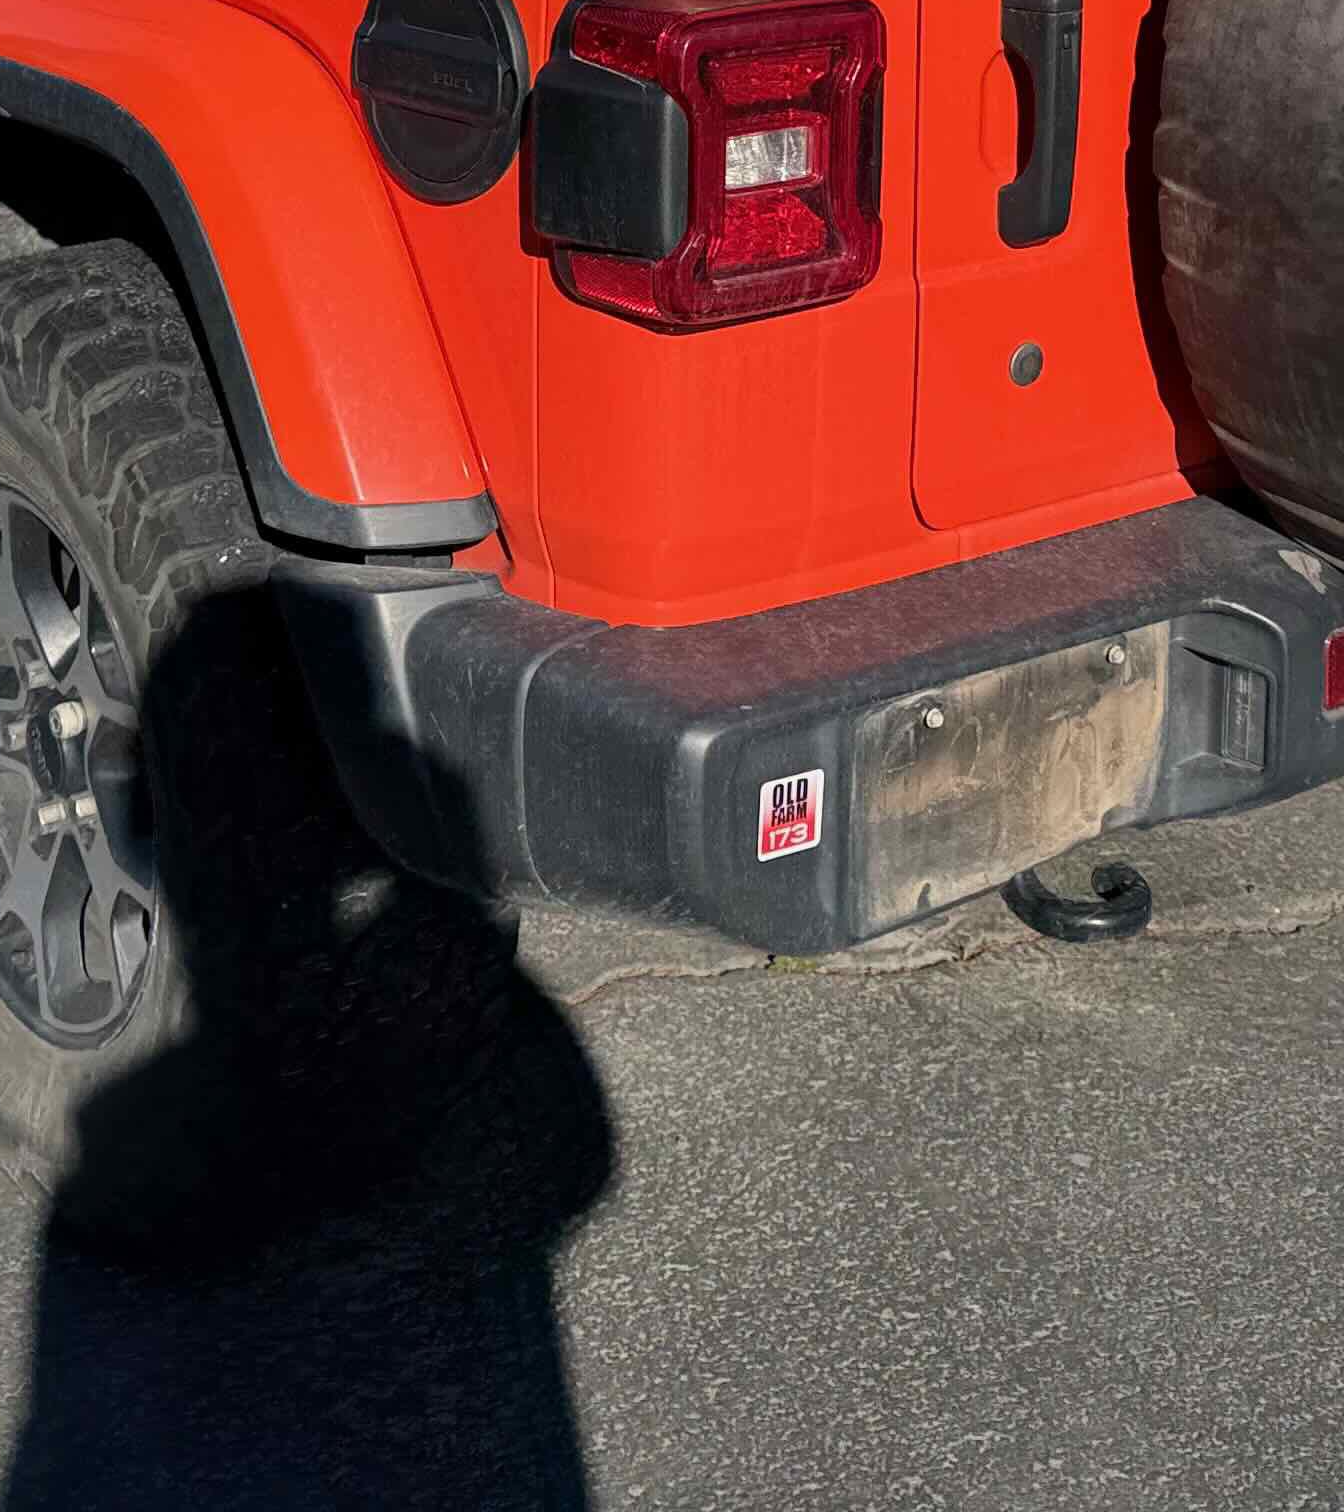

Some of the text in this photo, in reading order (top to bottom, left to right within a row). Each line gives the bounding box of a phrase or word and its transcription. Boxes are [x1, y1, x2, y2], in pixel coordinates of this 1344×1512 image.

[772, 777, 809, 809] OLD
[770, 801, 808, 828] FARM
[768, 822, 809, 850] 173
